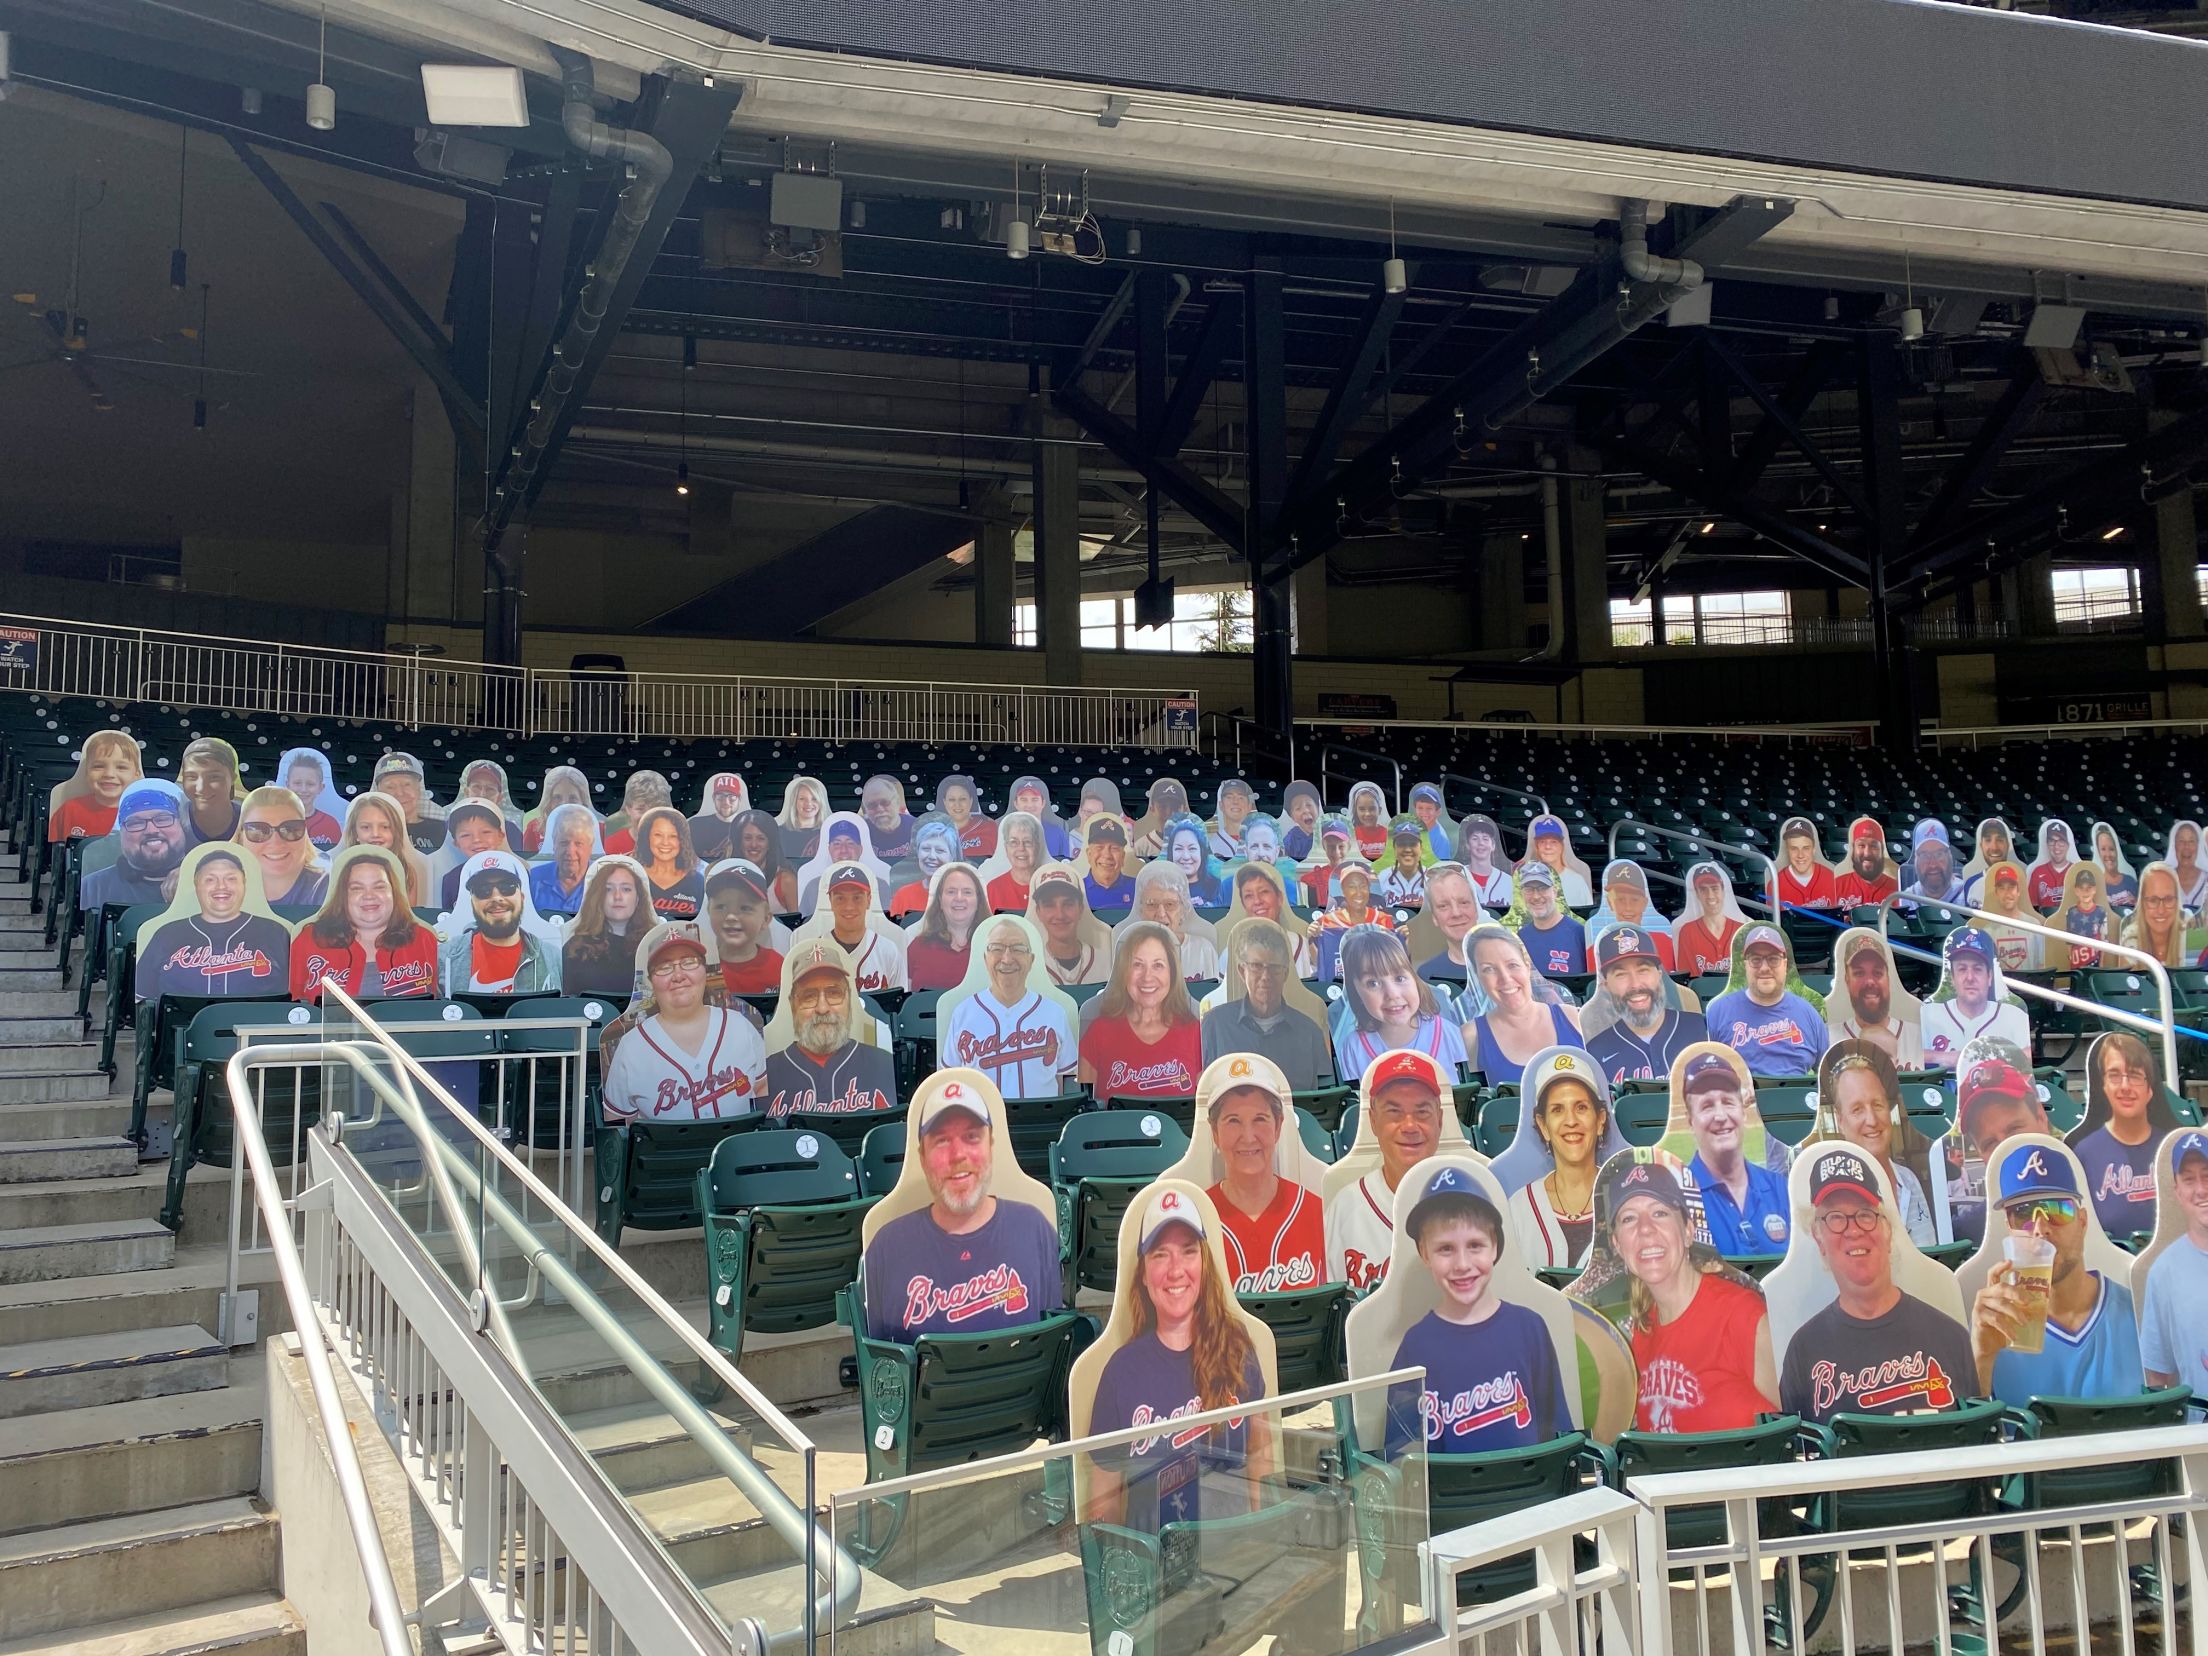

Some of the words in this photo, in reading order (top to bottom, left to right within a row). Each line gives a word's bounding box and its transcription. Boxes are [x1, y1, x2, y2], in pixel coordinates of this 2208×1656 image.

[0, 629, 36, 640] AUTION
[2057, 703, 2104, 722] 1871
[716, 775, 736, 788] ATL
[163, 942, 253, 971] Atlanta
[957, 1025, 1048, 1064] Braves
[1731, 1015, 1794, 1053] Braves
[1107, 1059, 1178, 1090] Braves
[654, 1066, 735, 1116] Braves
[766, 1076, 870, 1118] Atlanta
[2182, 1133, 2202, 1149] A
[1432, 1167, 1455, 1191] A
[1621, 1165, 1649, 1188] A
[2016, 1150, 2048, 1181] A
[902, 1263, 1009, 1330] Braves
[1812, 1351, 1925, 1417] Braves
[1418, 1371, 1514, 1440] Braves
